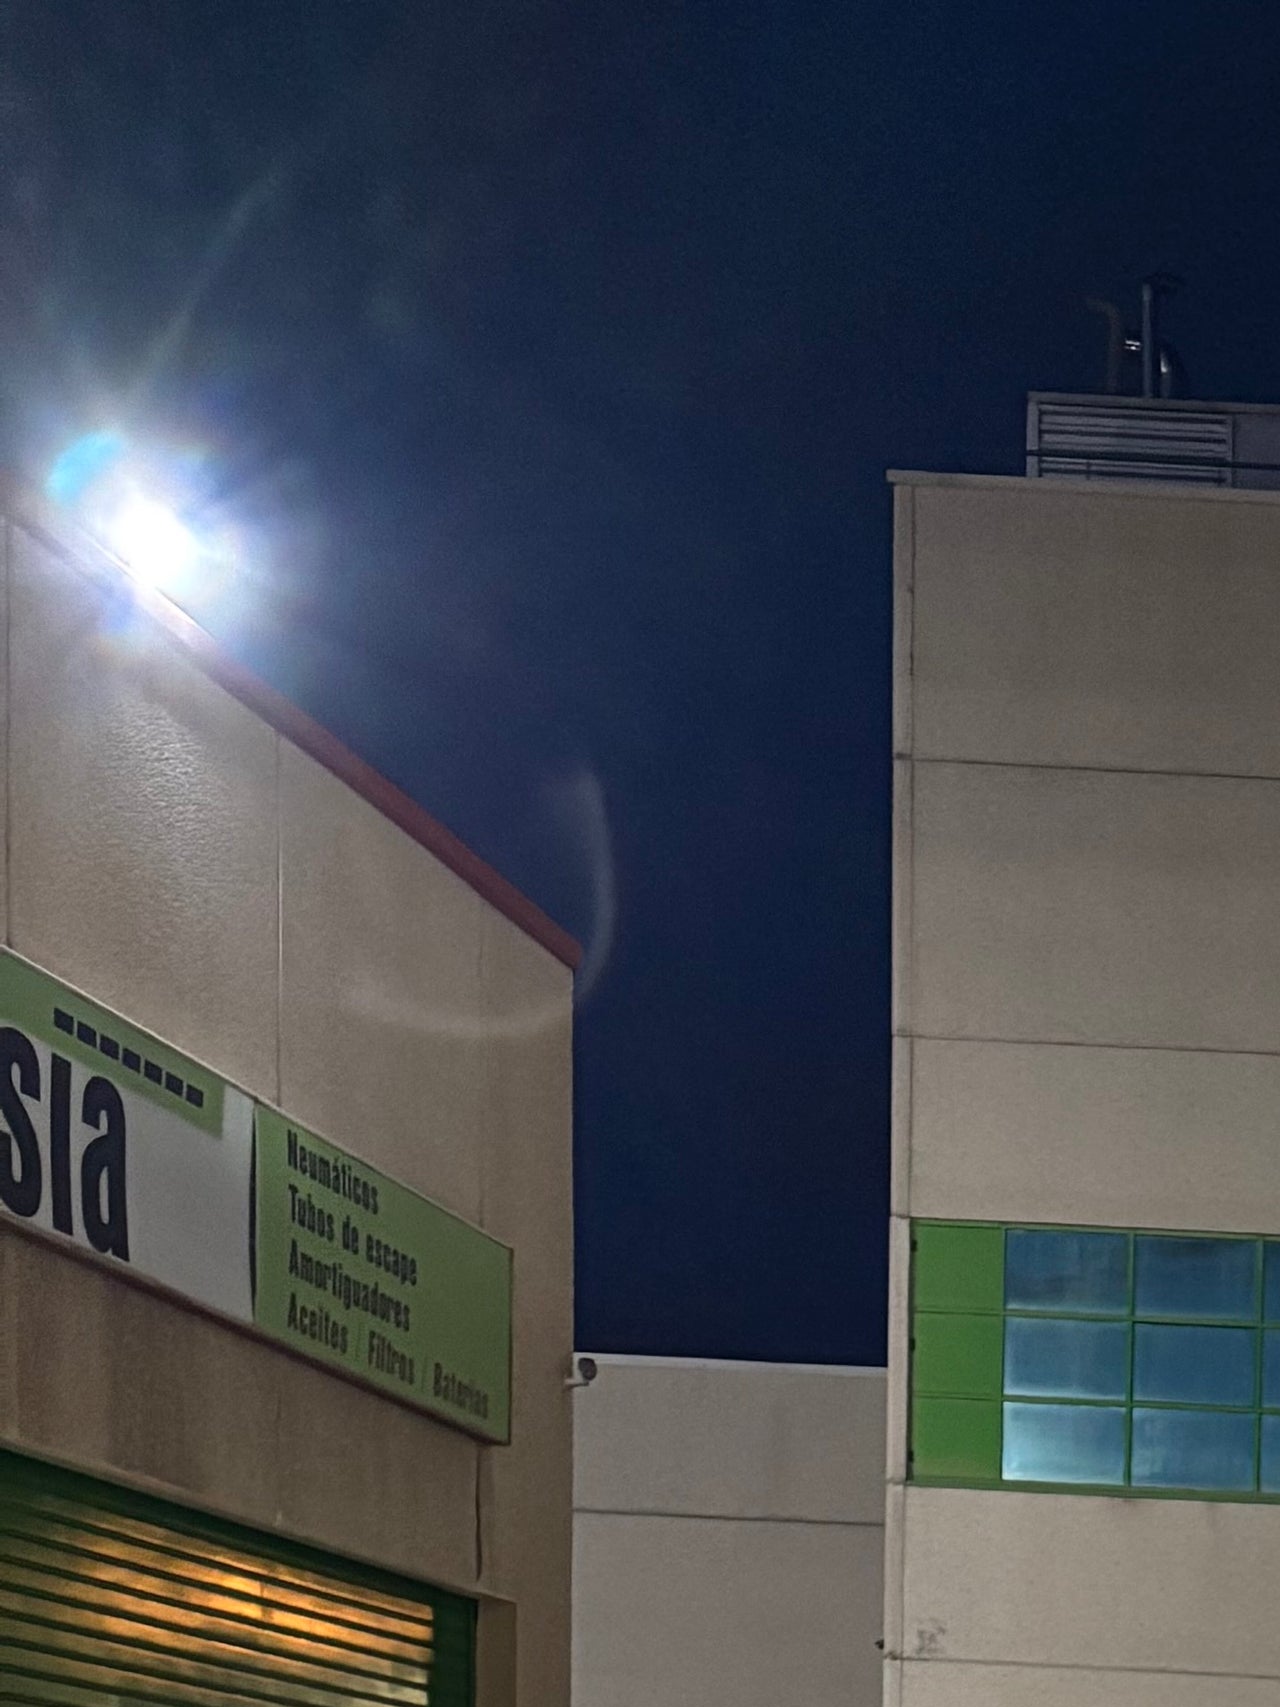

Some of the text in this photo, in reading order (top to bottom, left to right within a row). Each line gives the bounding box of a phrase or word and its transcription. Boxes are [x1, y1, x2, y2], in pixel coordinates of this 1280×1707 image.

[287, 1129, 379, 1214] Neumáticos
[288, 1184, 417, 1286] Tubos de escape
[289, 1238, 410, 1332] Amortiguadores
[287, 1292, 349, 1354] Aceites
[368, 1330, 415, 1386] Filtros
